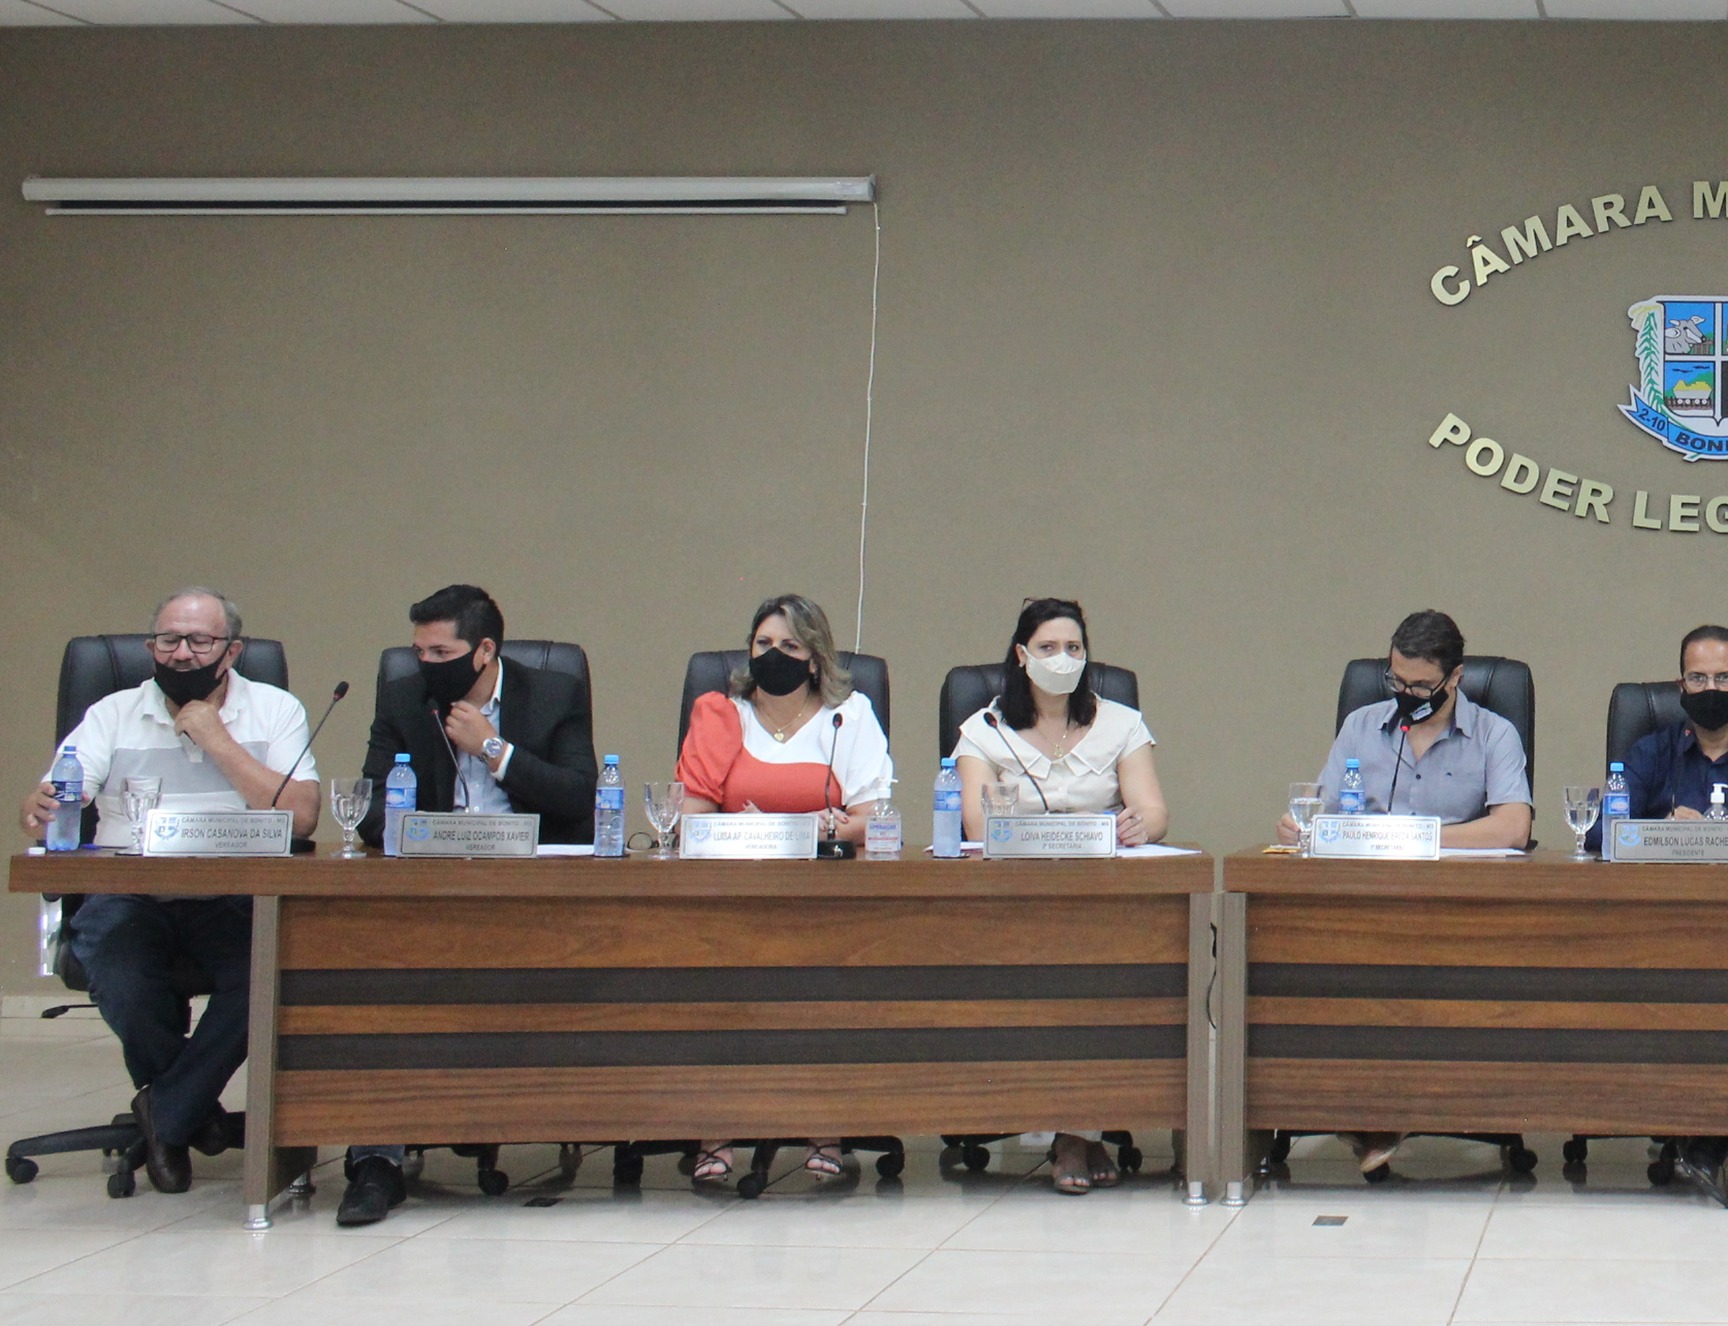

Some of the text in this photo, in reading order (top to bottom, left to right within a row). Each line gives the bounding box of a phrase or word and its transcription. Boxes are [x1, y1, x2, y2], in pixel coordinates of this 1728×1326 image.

[1429, 185, 1673, 307] CÂMARA
[1638, 408, 1665, 432] 2-10
[1428, 412, 1614, 523] PODER
[182, 829, 282, 839] IRSON CASANOVA DA SILVA
[474, 832, 505, 841] OCAMPOS
[506, 832, 529, 841] XAVIER
[714, 831, 731, 841] LUISA
[744, 832, 783, 841] CAVALHEIRO
[785, 832, 794, 840] DE
[1021, 832, 1103, 841] LOIVA HEIDECKE SCHIAVO
[1342, 832, 1361, 840] PAULO
[1362, 832, 1389, 840] HENRIQUE
[1644, 837, 1679, 846] EDMILSON
[1681, 837, 1704, 846] LUCAS
